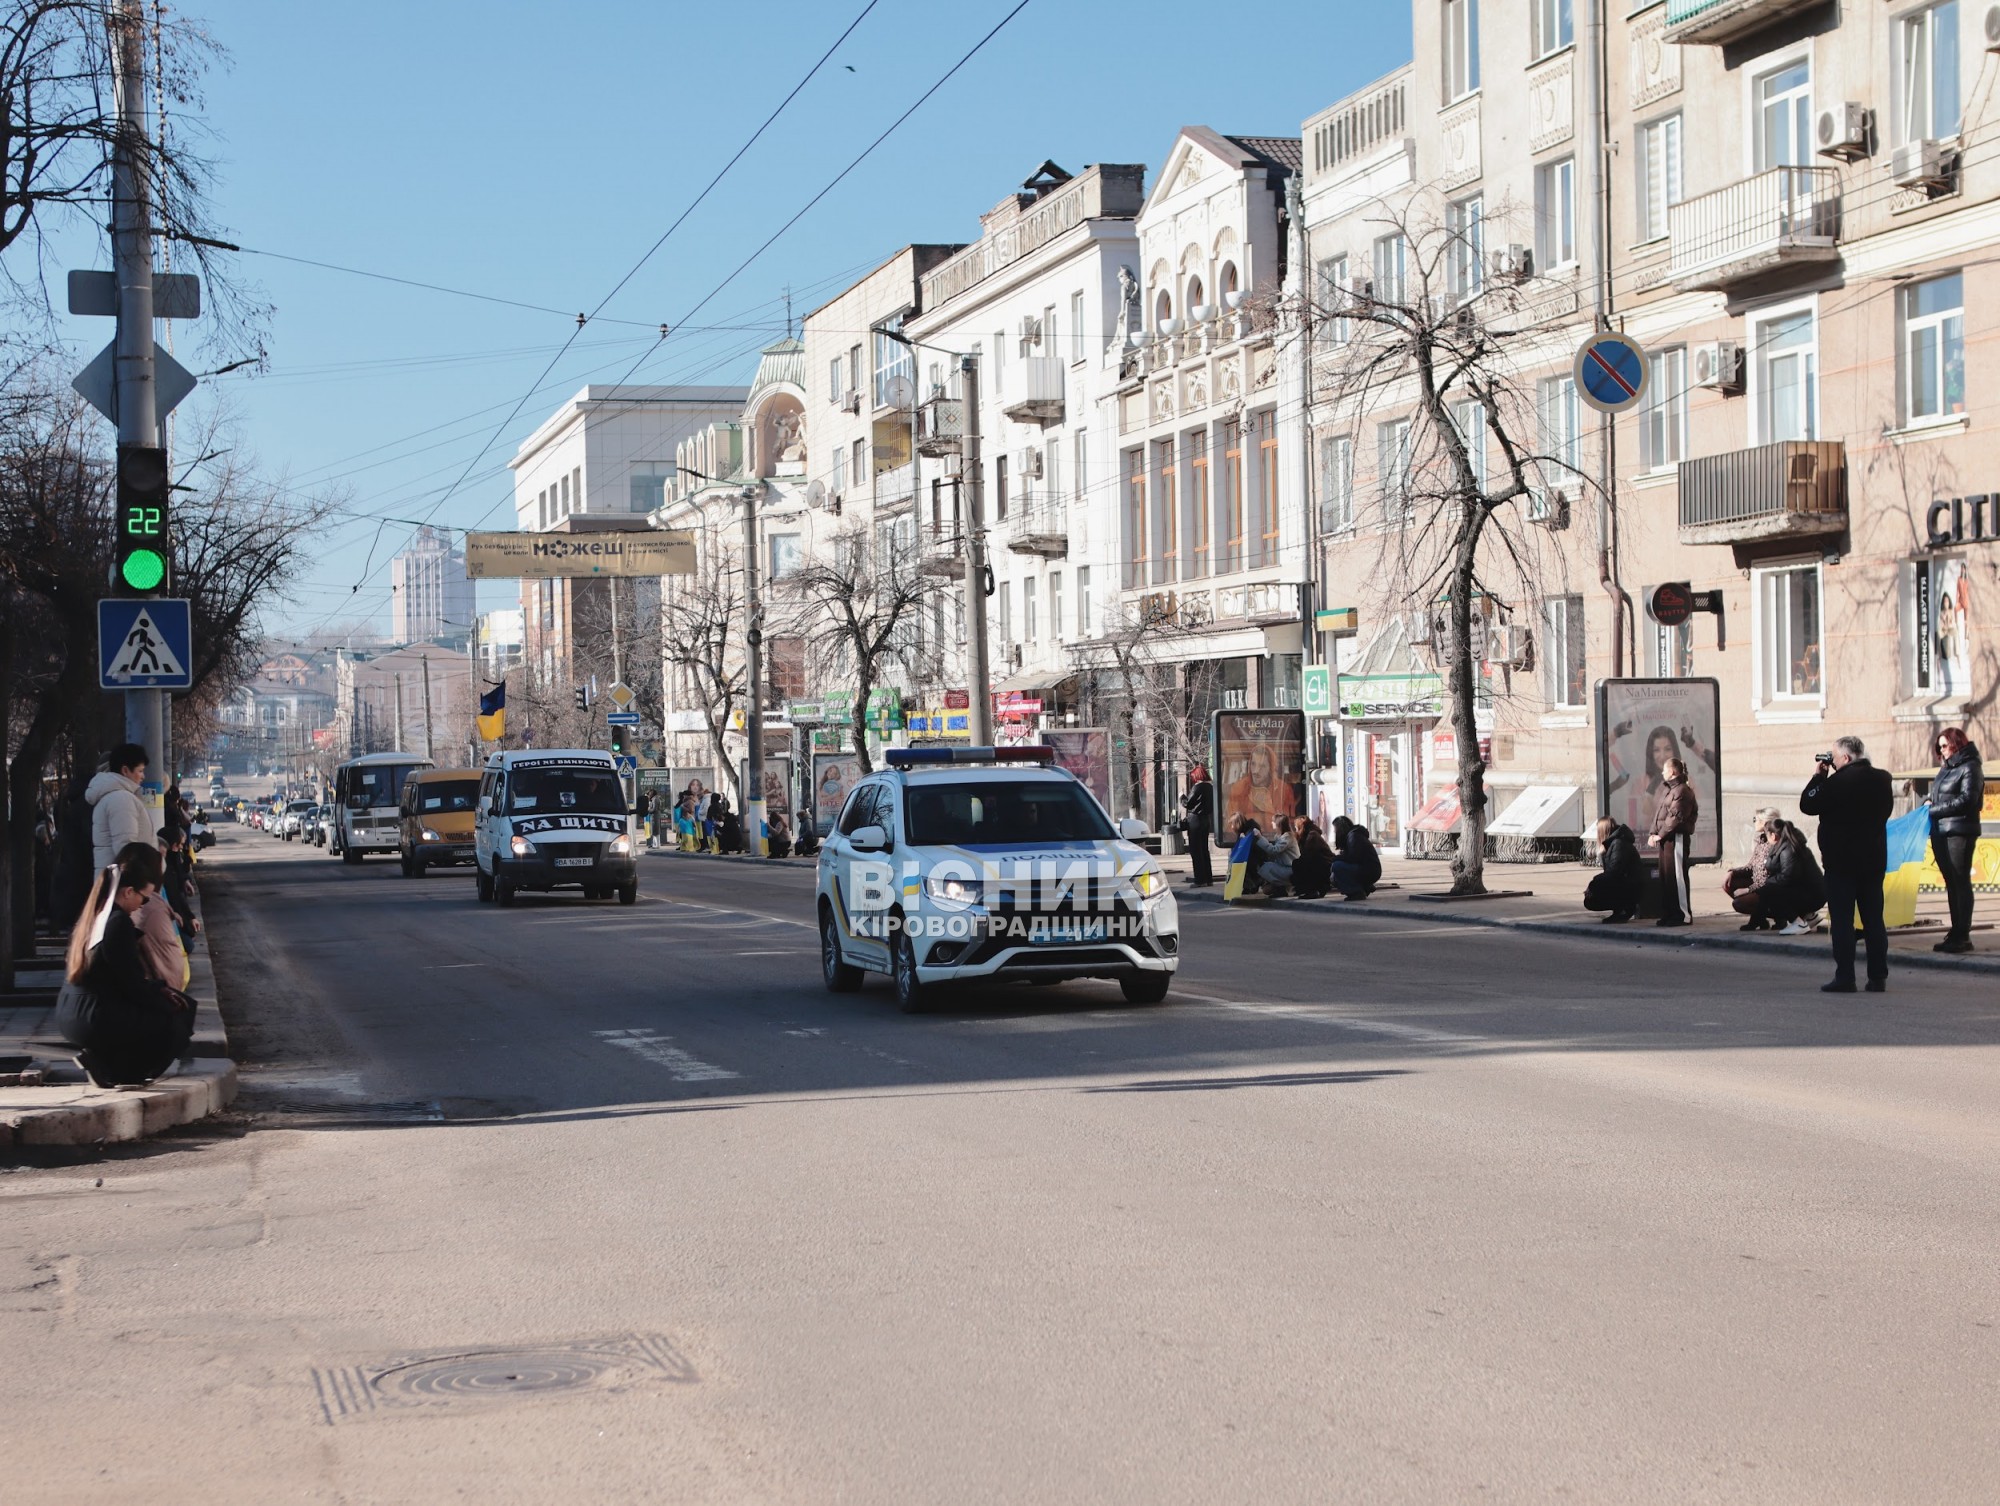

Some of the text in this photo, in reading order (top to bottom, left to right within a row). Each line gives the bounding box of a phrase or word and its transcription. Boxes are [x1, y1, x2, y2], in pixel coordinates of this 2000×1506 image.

[128, 507, 160, 534] 22
[1625, 687, 1689, 698] NaManicure
[1364, 702, 1433, 715] SERVICE
[1234, 717, 1284, 728] TrueMan
[513, 761, 541, 769] ГЕРОЇ
[557, 759, 611, 767] ВМИРАЮТЬ
[1346, 744, 1354, 815] АДВОКАТ
[559, 816, 621, 831] ЩИТІ
[1001, 853, 1099, 862] ПОЛІЦІЯ
